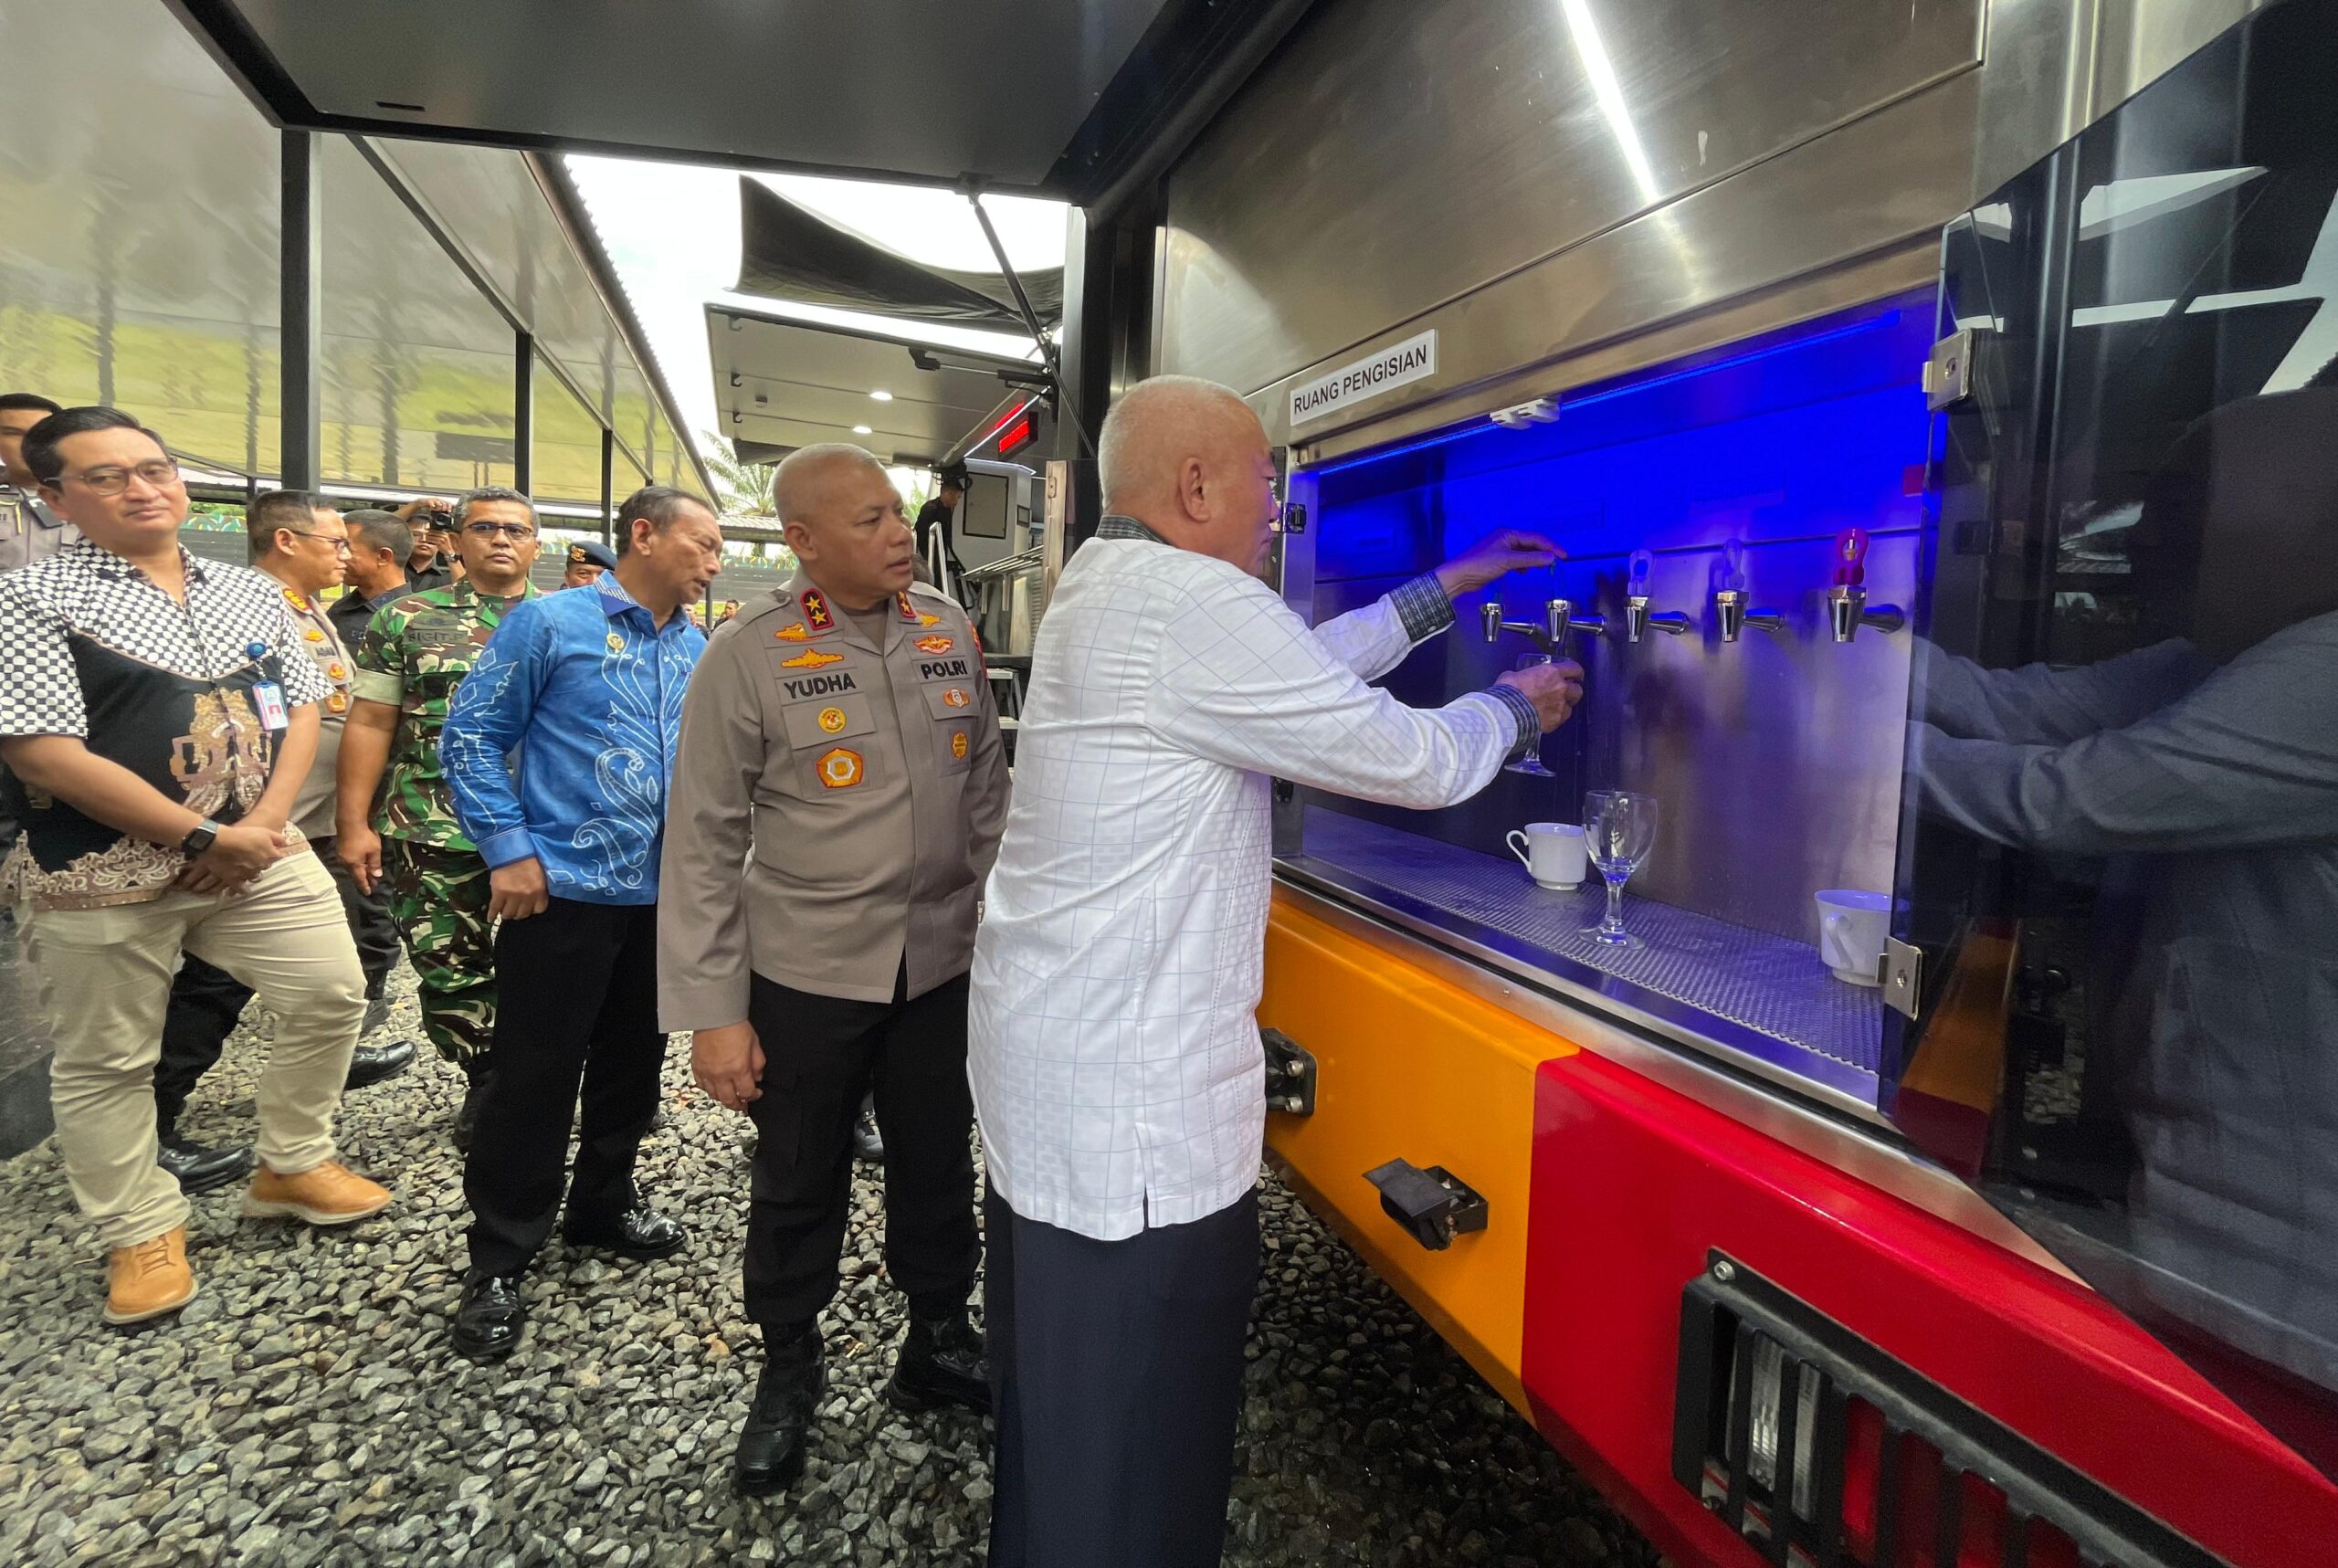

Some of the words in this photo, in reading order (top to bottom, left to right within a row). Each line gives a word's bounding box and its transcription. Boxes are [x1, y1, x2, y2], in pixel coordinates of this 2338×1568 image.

[1293, 382, 1339, 415] RUANG
[1343, 344, 1427, 395] PENGISIAN
[921, 660, 968, 679] POLRI
[784, 672, 857, 700] YUDHA
